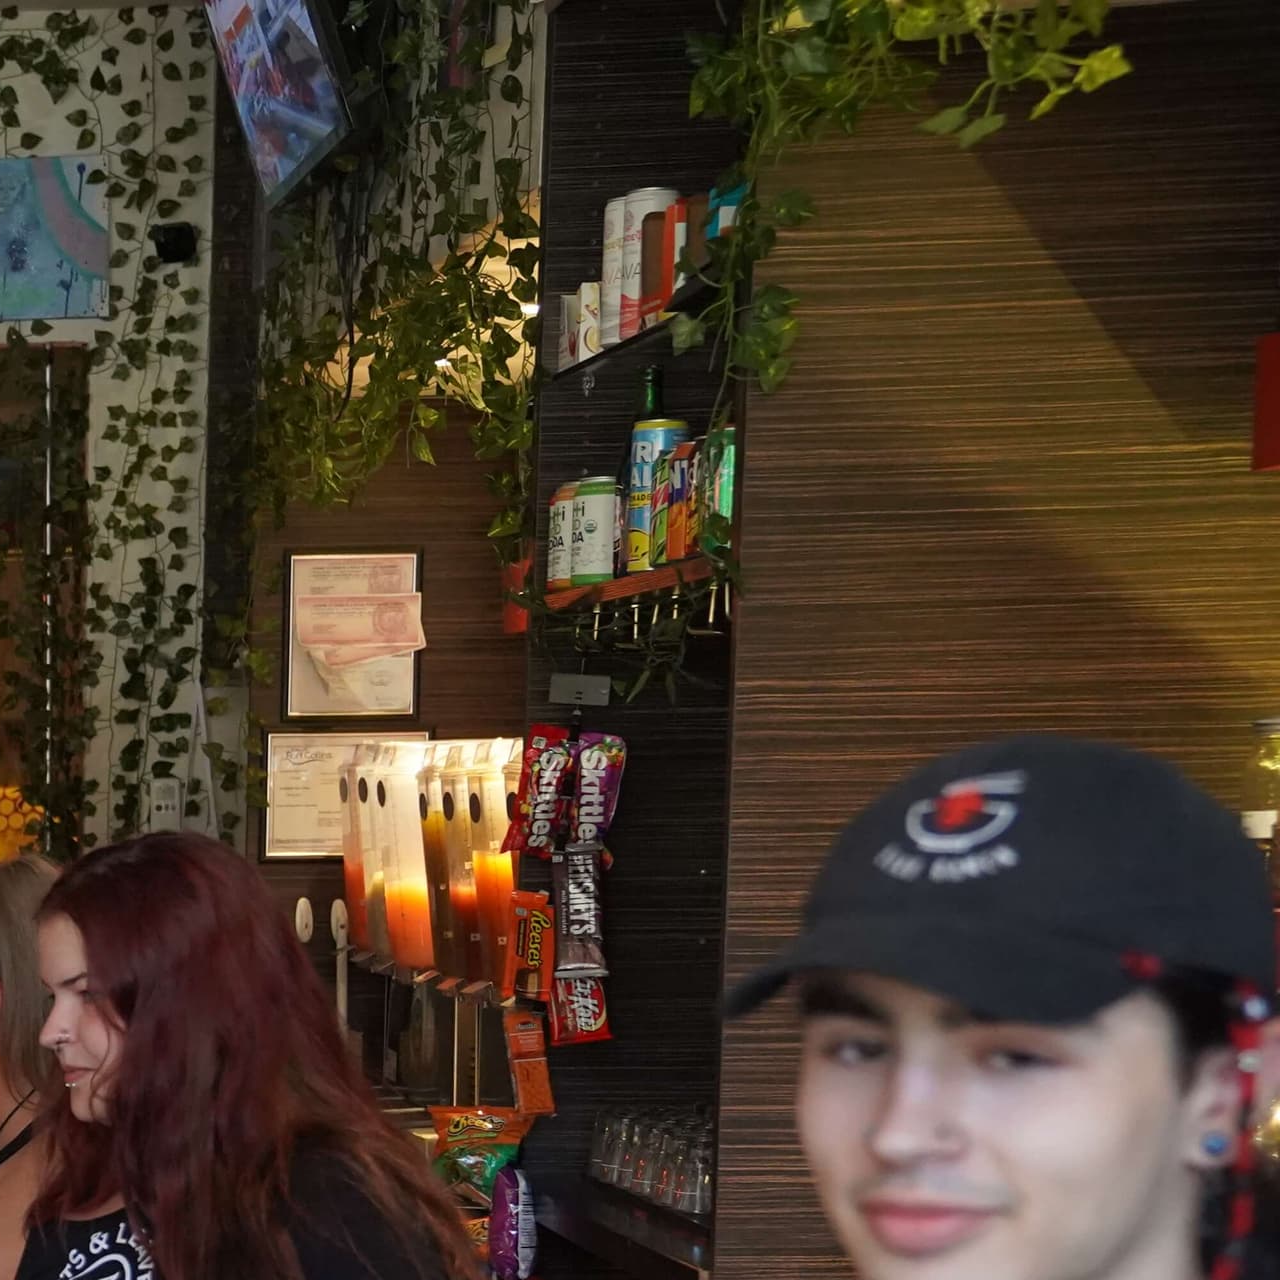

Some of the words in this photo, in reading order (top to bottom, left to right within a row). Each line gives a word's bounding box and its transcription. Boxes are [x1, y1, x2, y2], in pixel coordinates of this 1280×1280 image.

[527, 750, 565, 848] Skittles
[577, 748, 609, 845] Skittle
[567, 854, 597, 936] HERSHEY'S
[89, 1231, 110, 1254] &
